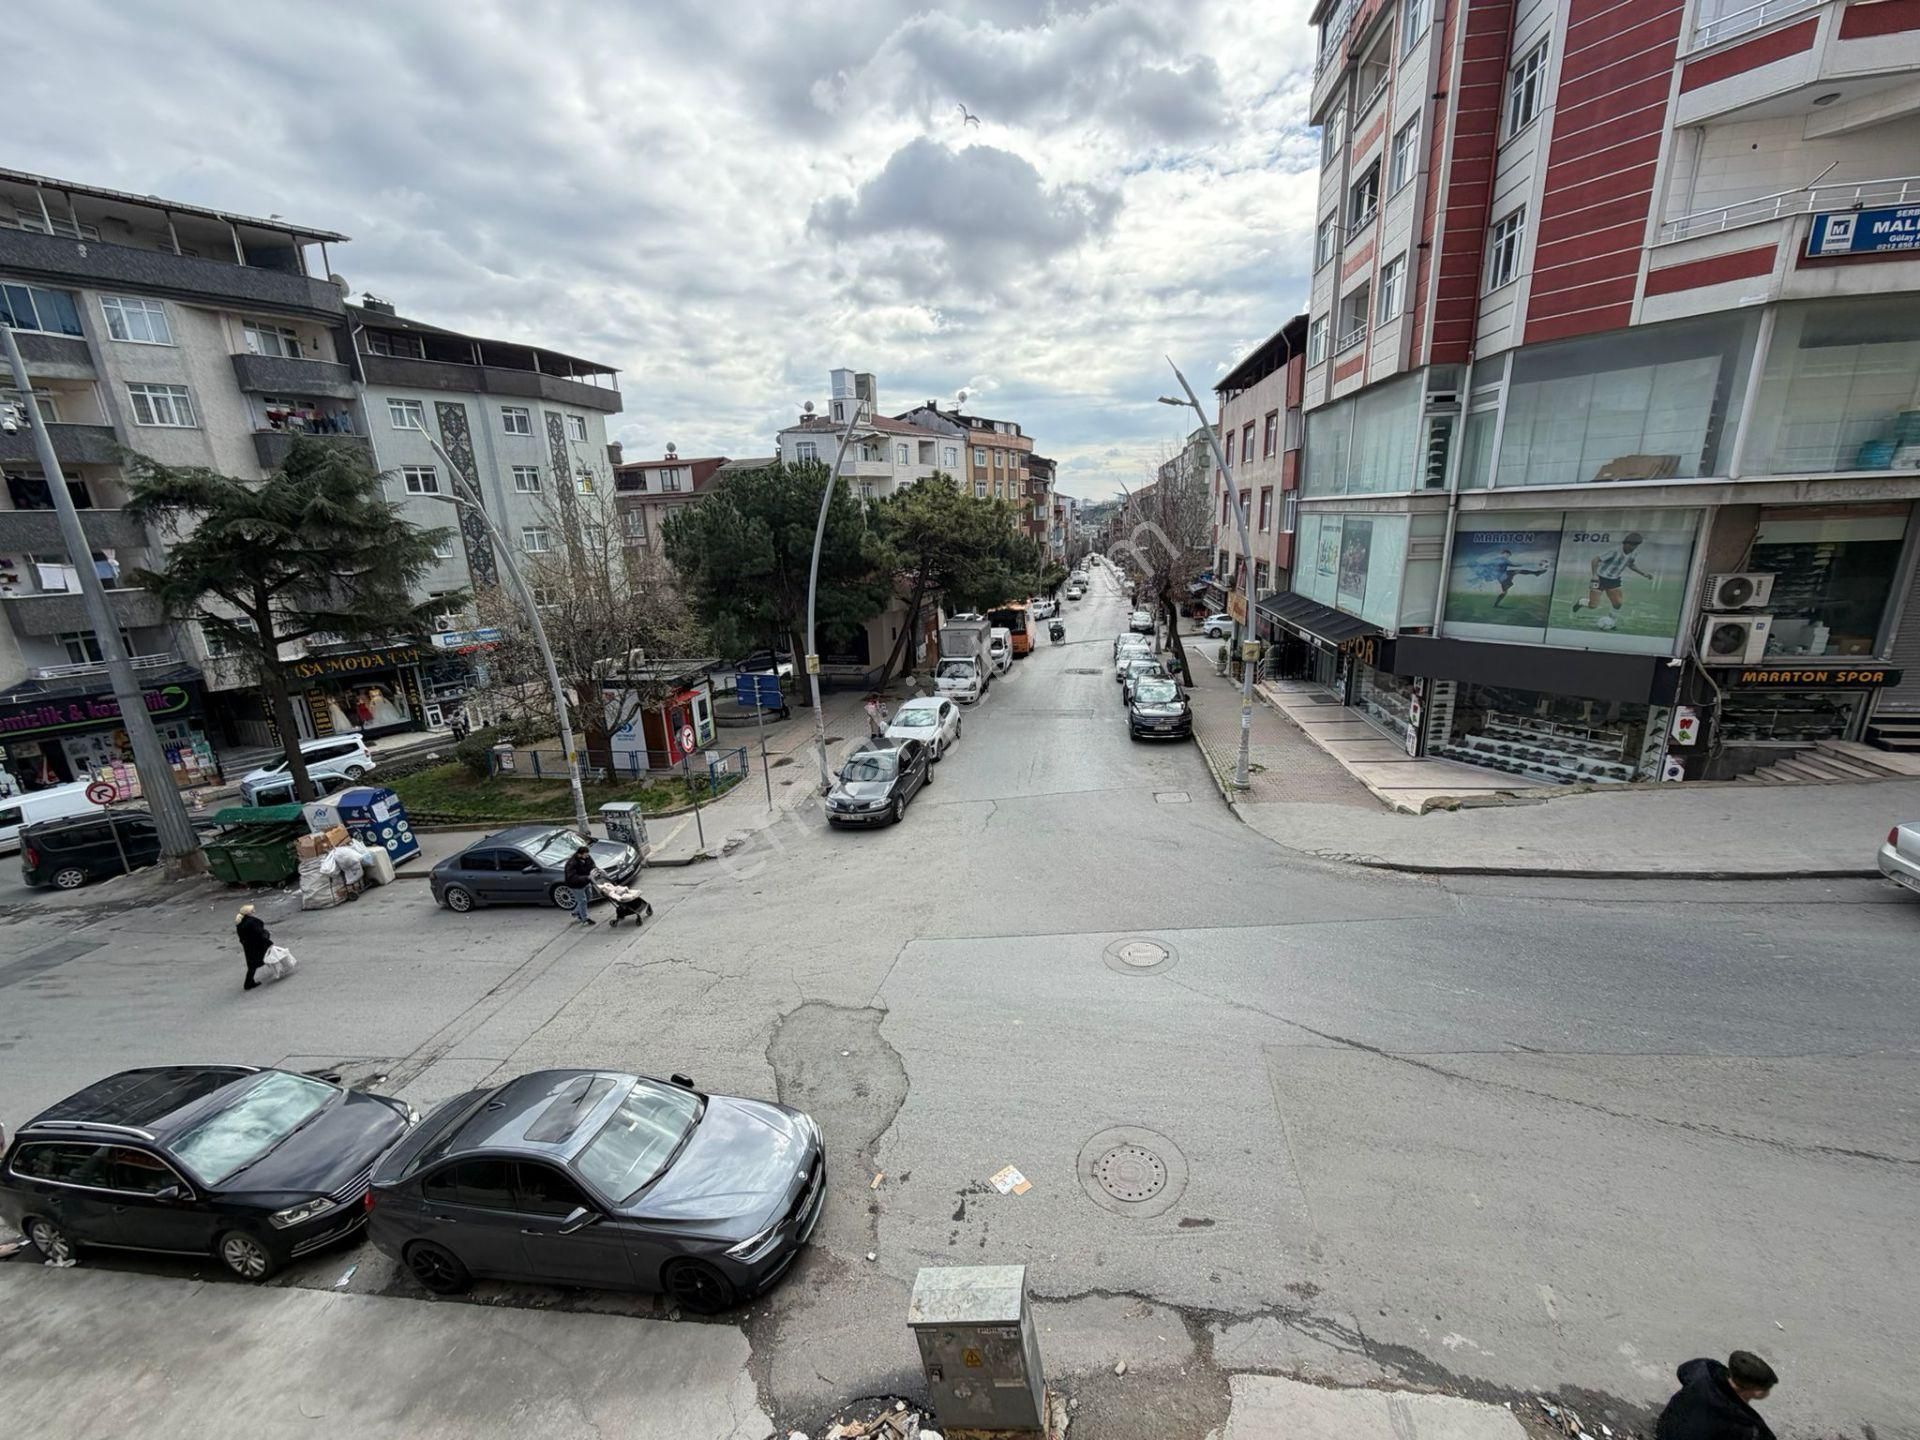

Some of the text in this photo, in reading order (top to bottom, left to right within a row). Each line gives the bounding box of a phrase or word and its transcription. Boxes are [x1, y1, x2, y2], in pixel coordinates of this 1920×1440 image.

[1473, 532, 1610, 543] MARATON SPOR
[1742, 671, 1884, 682] MARATON SPOR
[68, 704, 86, 722] &
